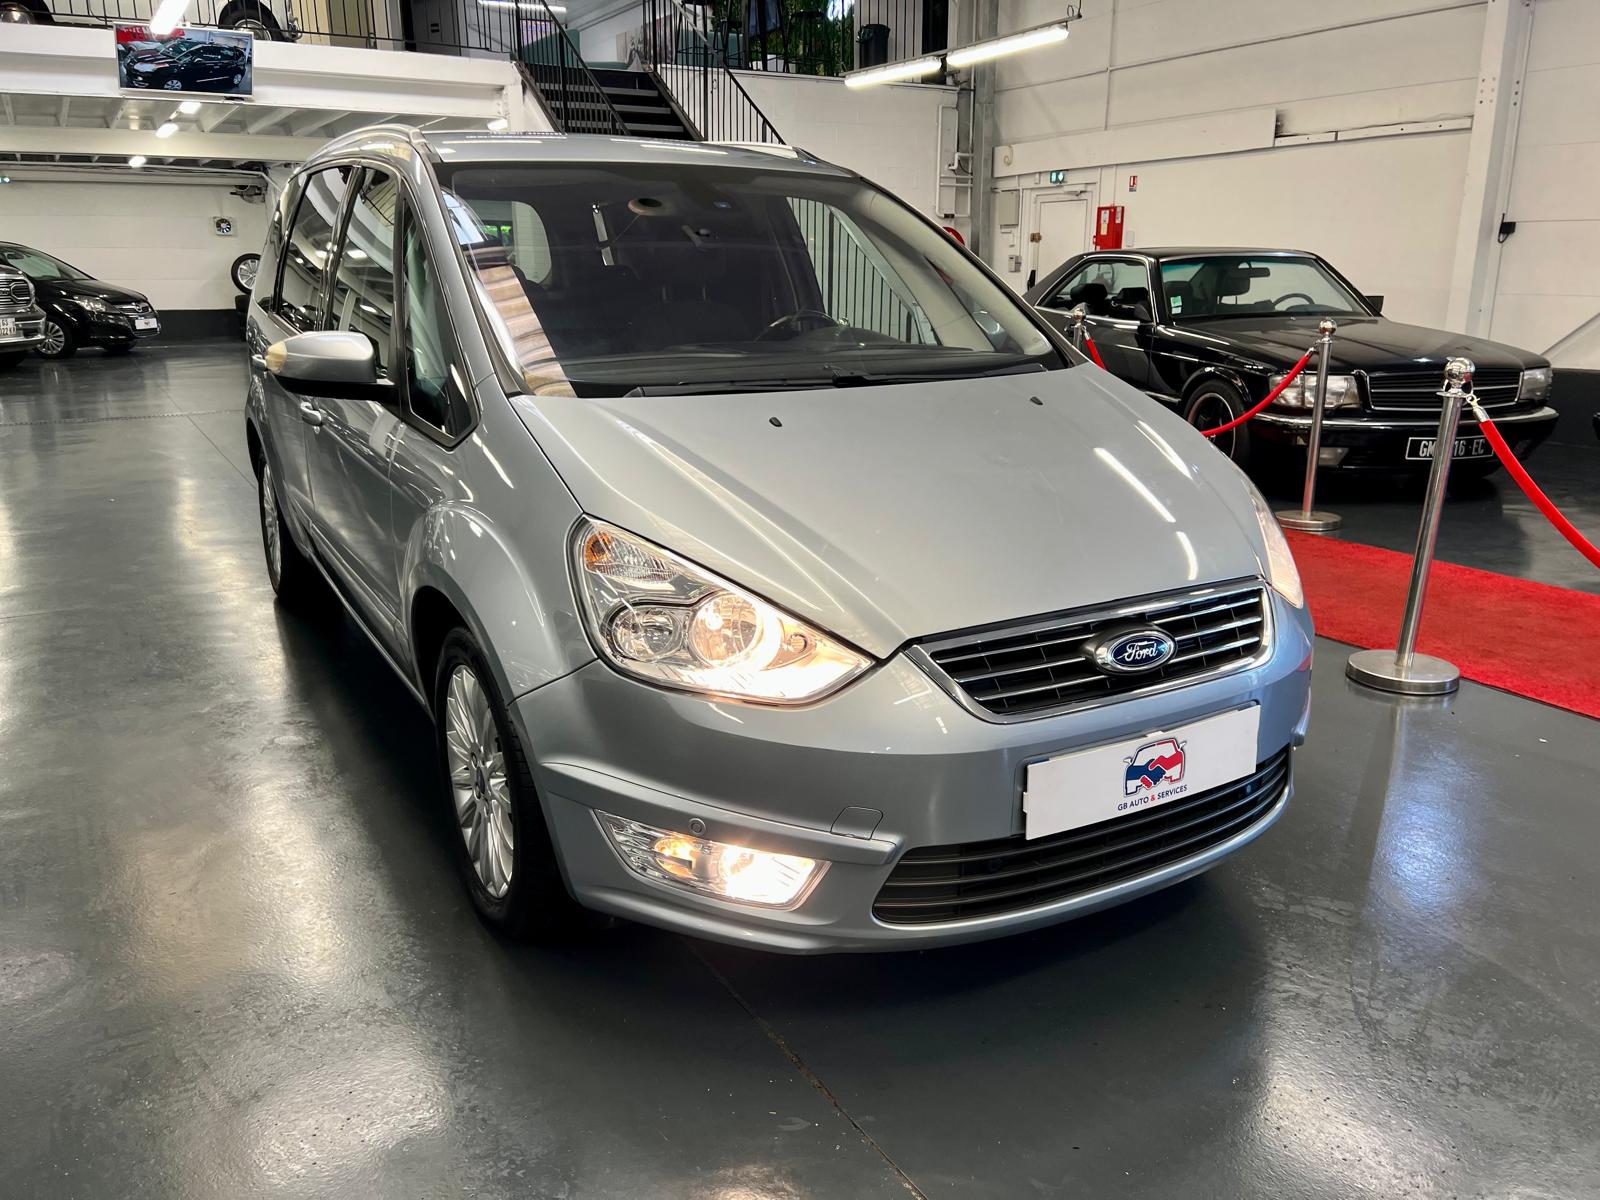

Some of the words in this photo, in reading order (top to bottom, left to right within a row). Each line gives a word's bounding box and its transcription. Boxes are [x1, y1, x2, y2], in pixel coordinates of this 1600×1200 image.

[1472, 439, 1485, 455] EC
[1116, 640, 1158, 662] Ford
[1117, 802, 1128, 811] GB
[1129, 796, 1149, 809] AUTO
[1157, 784, 1188, 800] SERVICES
